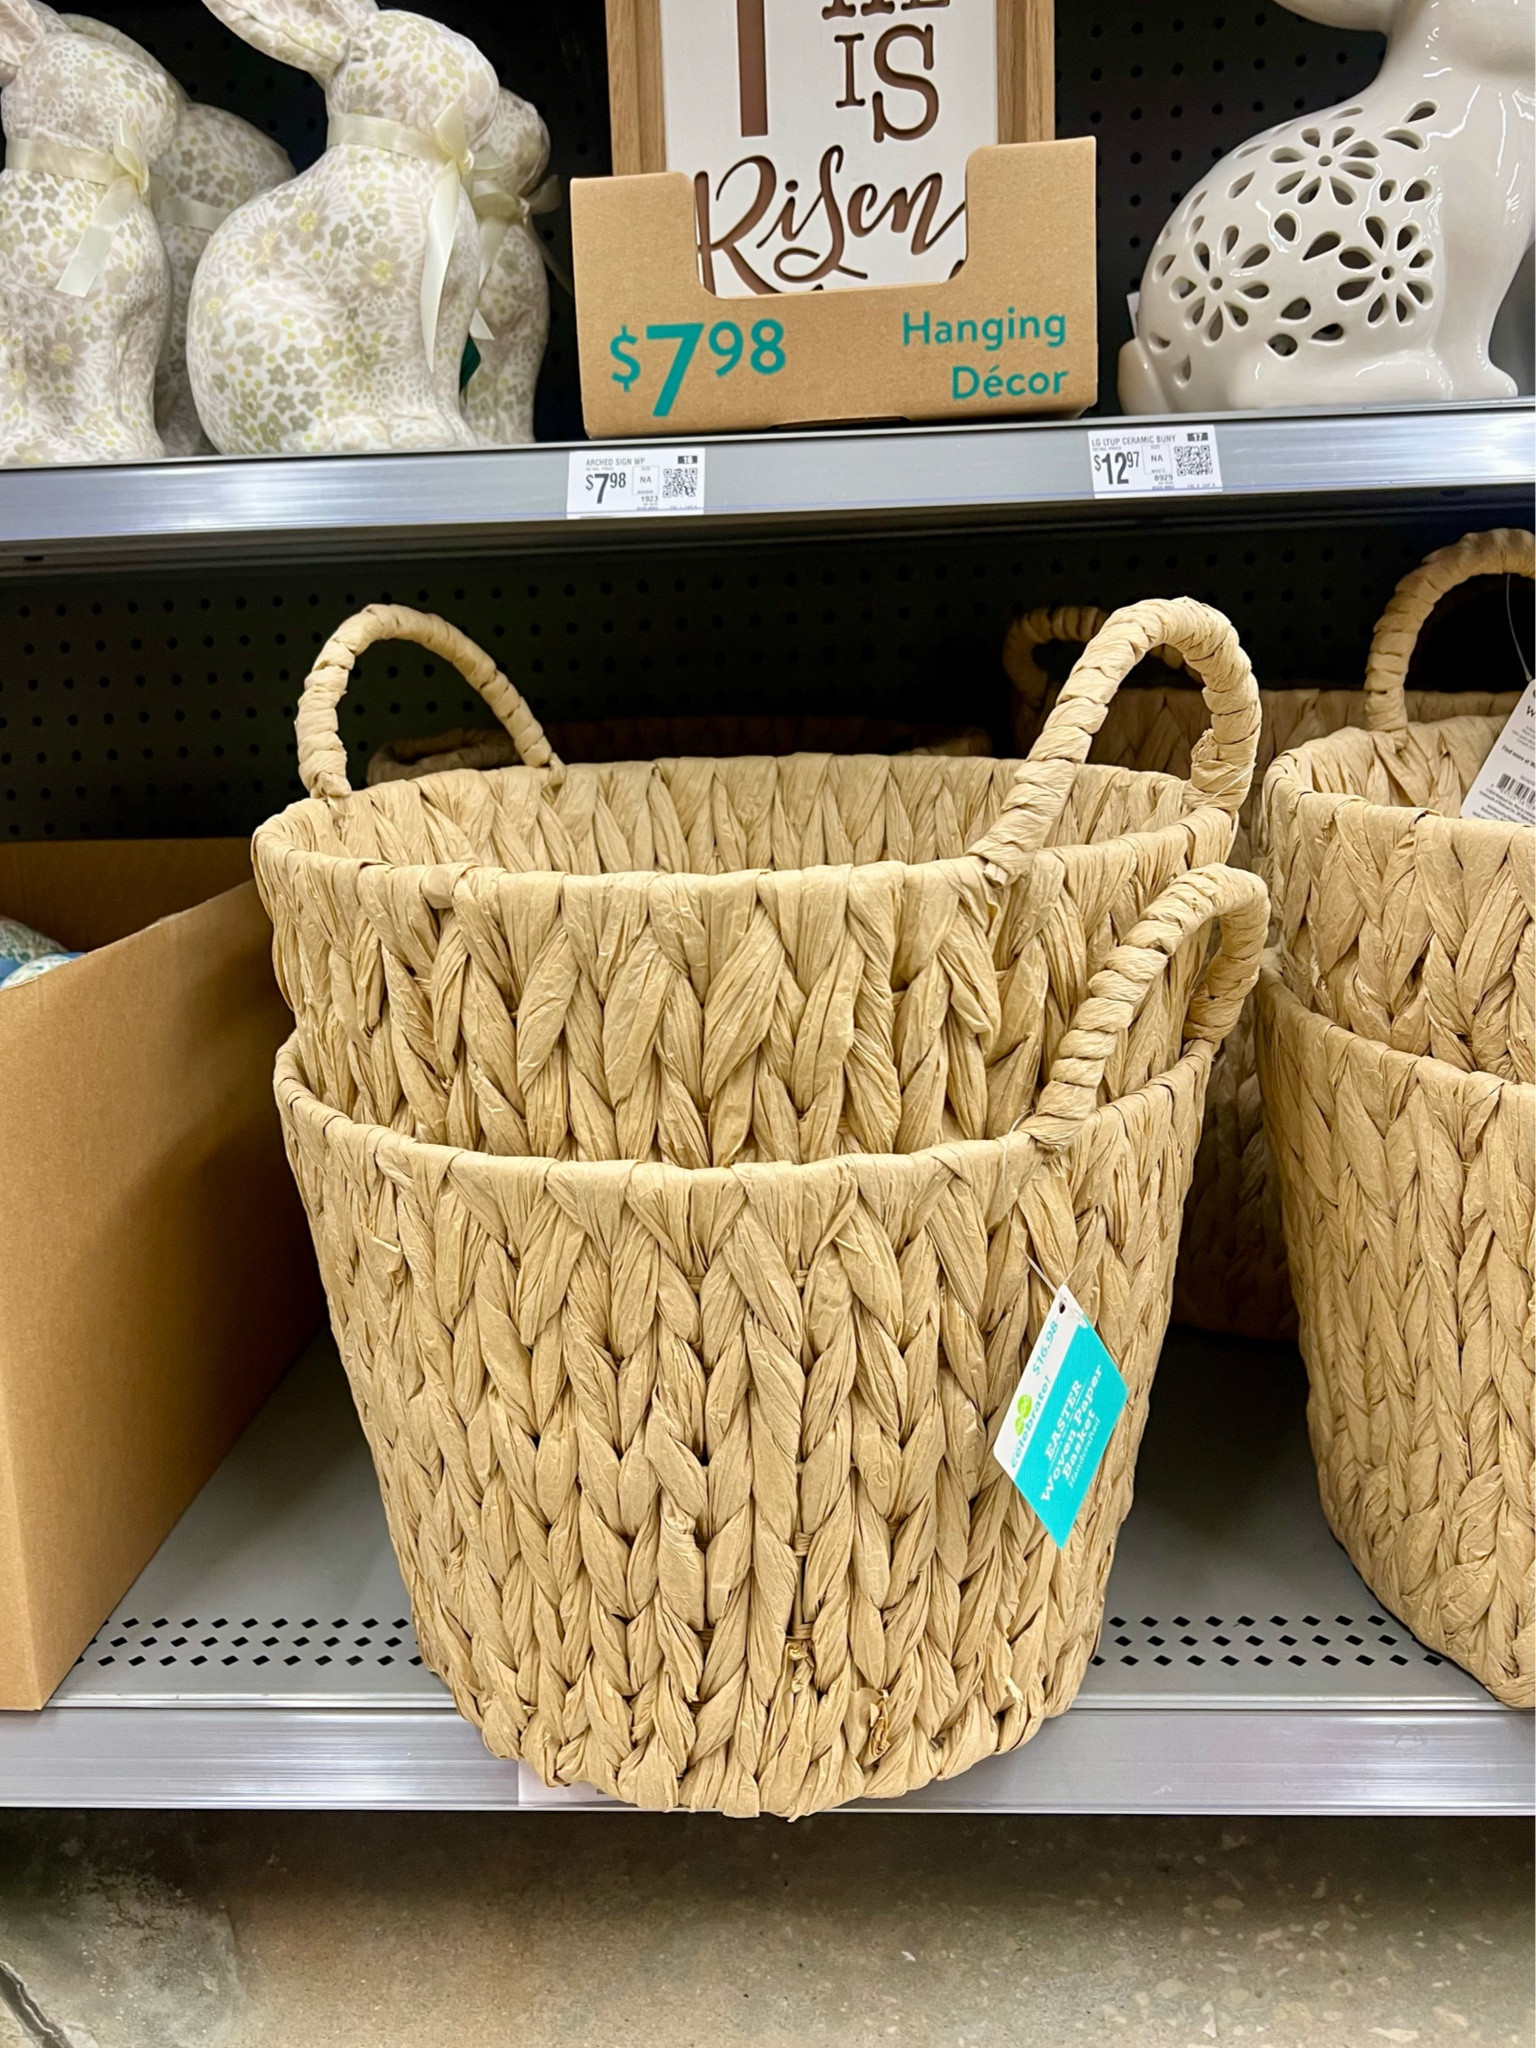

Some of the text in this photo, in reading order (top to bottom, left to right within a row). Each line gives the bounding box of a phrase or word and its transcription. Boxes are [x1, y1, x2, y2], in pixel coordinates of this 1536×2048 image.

[834, 23, 940, 143] IS
[694, 145, 966, 296] Risen
[902, 307, 1067, 352] Hanging
[951, 366, 1069, 400] Décor
[615, 457, 631, 466] SIGN
[1092, 439, 1101, 447] LG
[1122, 436, 1154, 444] CERAMIC
[1156, 435, 1176, 443] BUNY
[1032, 1320, 1059, 1376] $16.98
[1010, 1375, 1052, 1468] celebrate!
[1040, 1364, 1103, 1502] Woven Paper
[1044, 1379, 1083, 1461] EASTER
[1061, 1408, 1096, 1481] Basket
